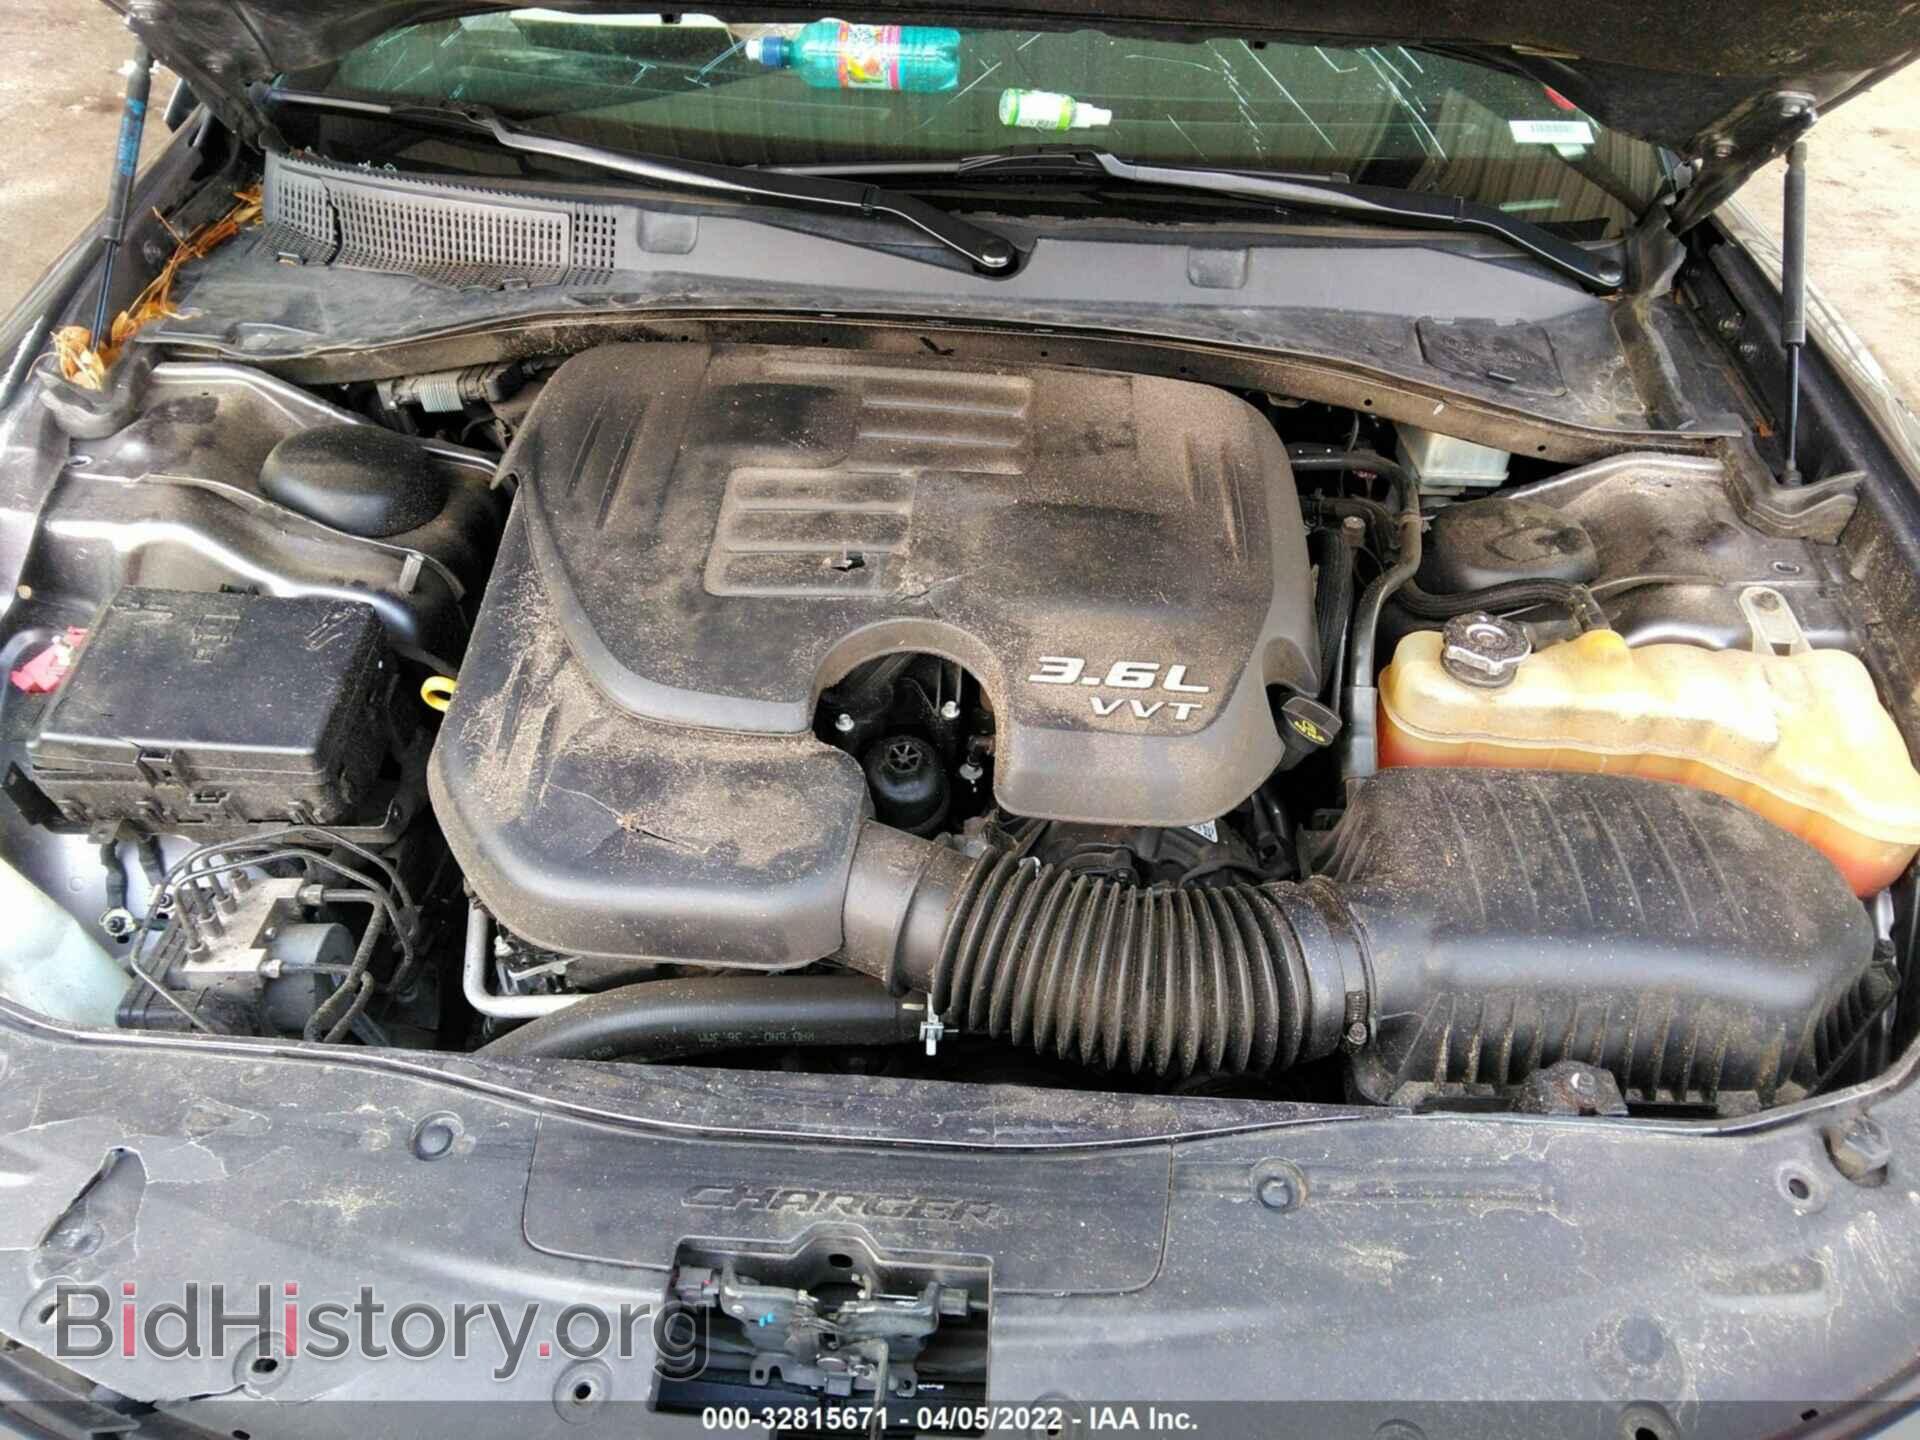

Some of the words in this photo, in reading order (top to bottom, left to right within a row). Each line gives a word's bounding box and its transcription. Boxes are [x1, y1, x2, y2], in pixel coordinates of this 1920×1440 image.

[1028, 656, 1209, 693] 3.6L
[1090, 697, 1202, 721] VVT
[680, 1184, 1003, 1229] CHARGER
